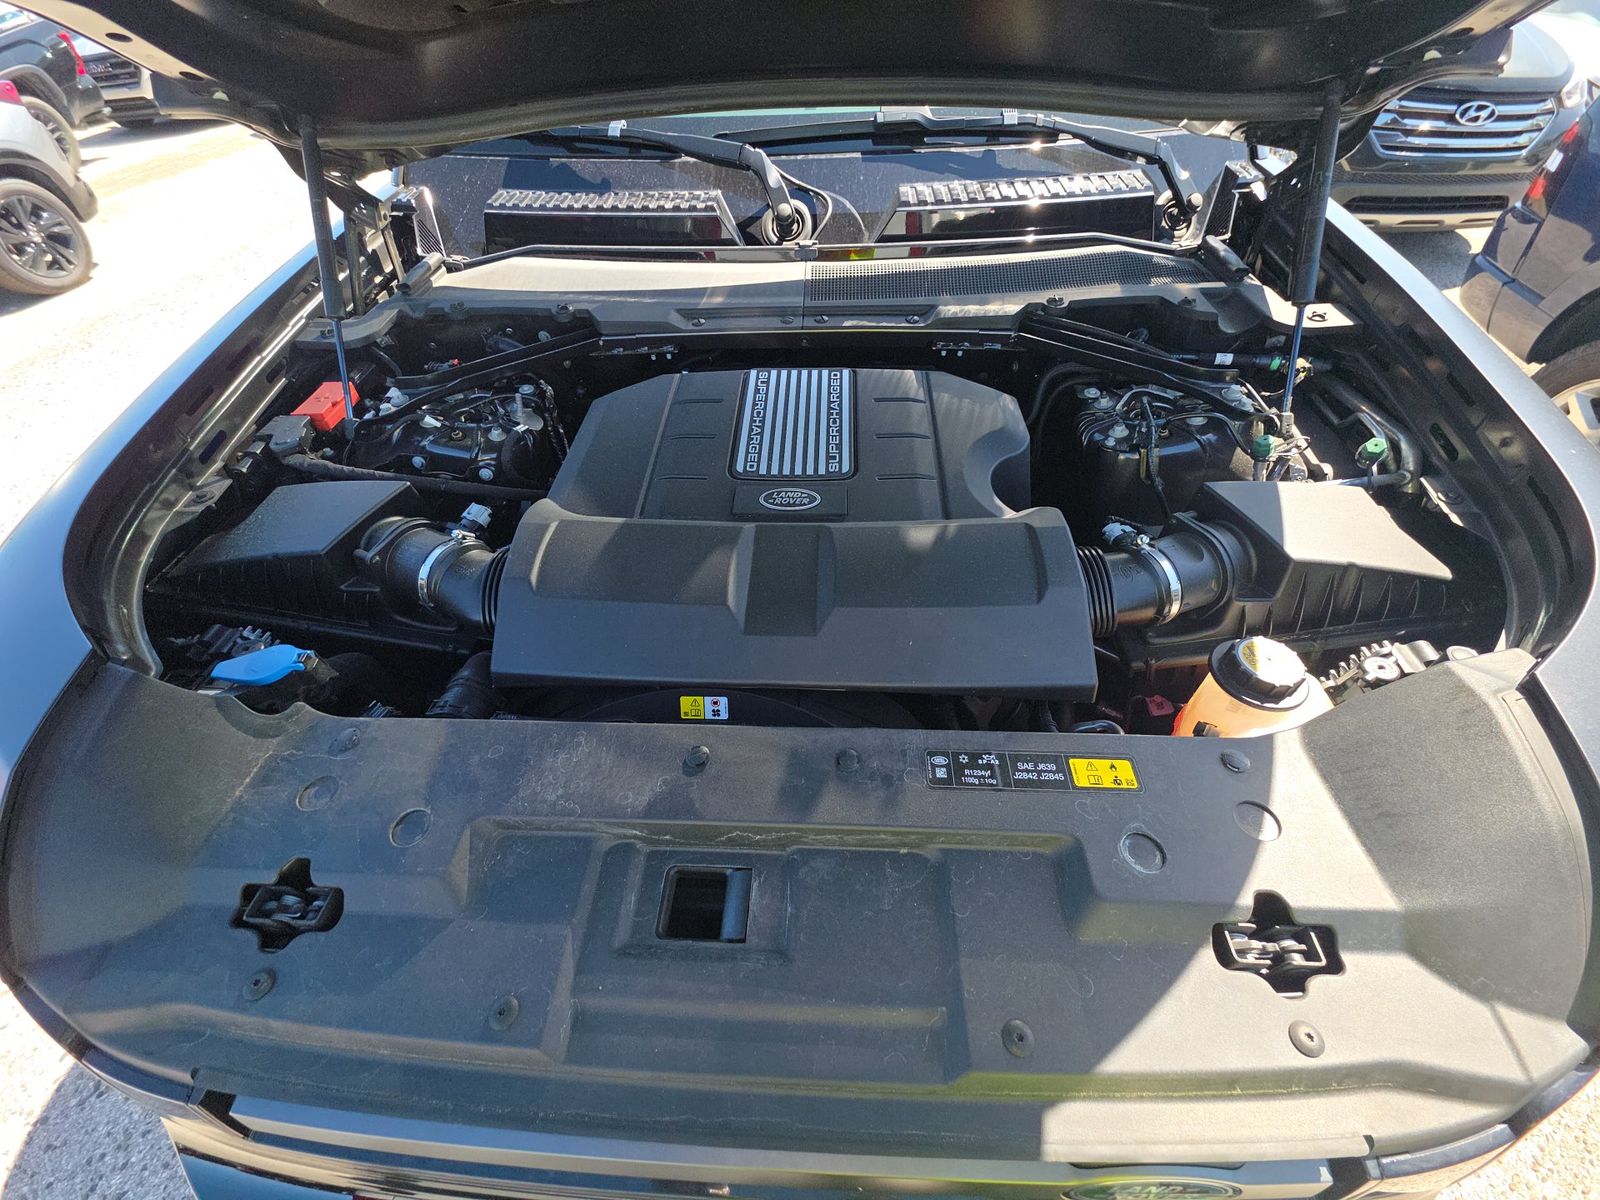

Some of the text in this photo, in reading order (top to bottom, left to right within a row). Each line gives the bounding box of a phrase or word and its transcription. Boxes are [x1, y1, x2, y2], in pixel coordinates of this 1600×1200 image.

[747, 371, 769, 472] SUPERCHARGED
[829, 371, 840, 472] SUPERCHARGED
[1013, 771, 1064, 780] J2842 J2845
[1017, 762, 1035, 770] SAE
